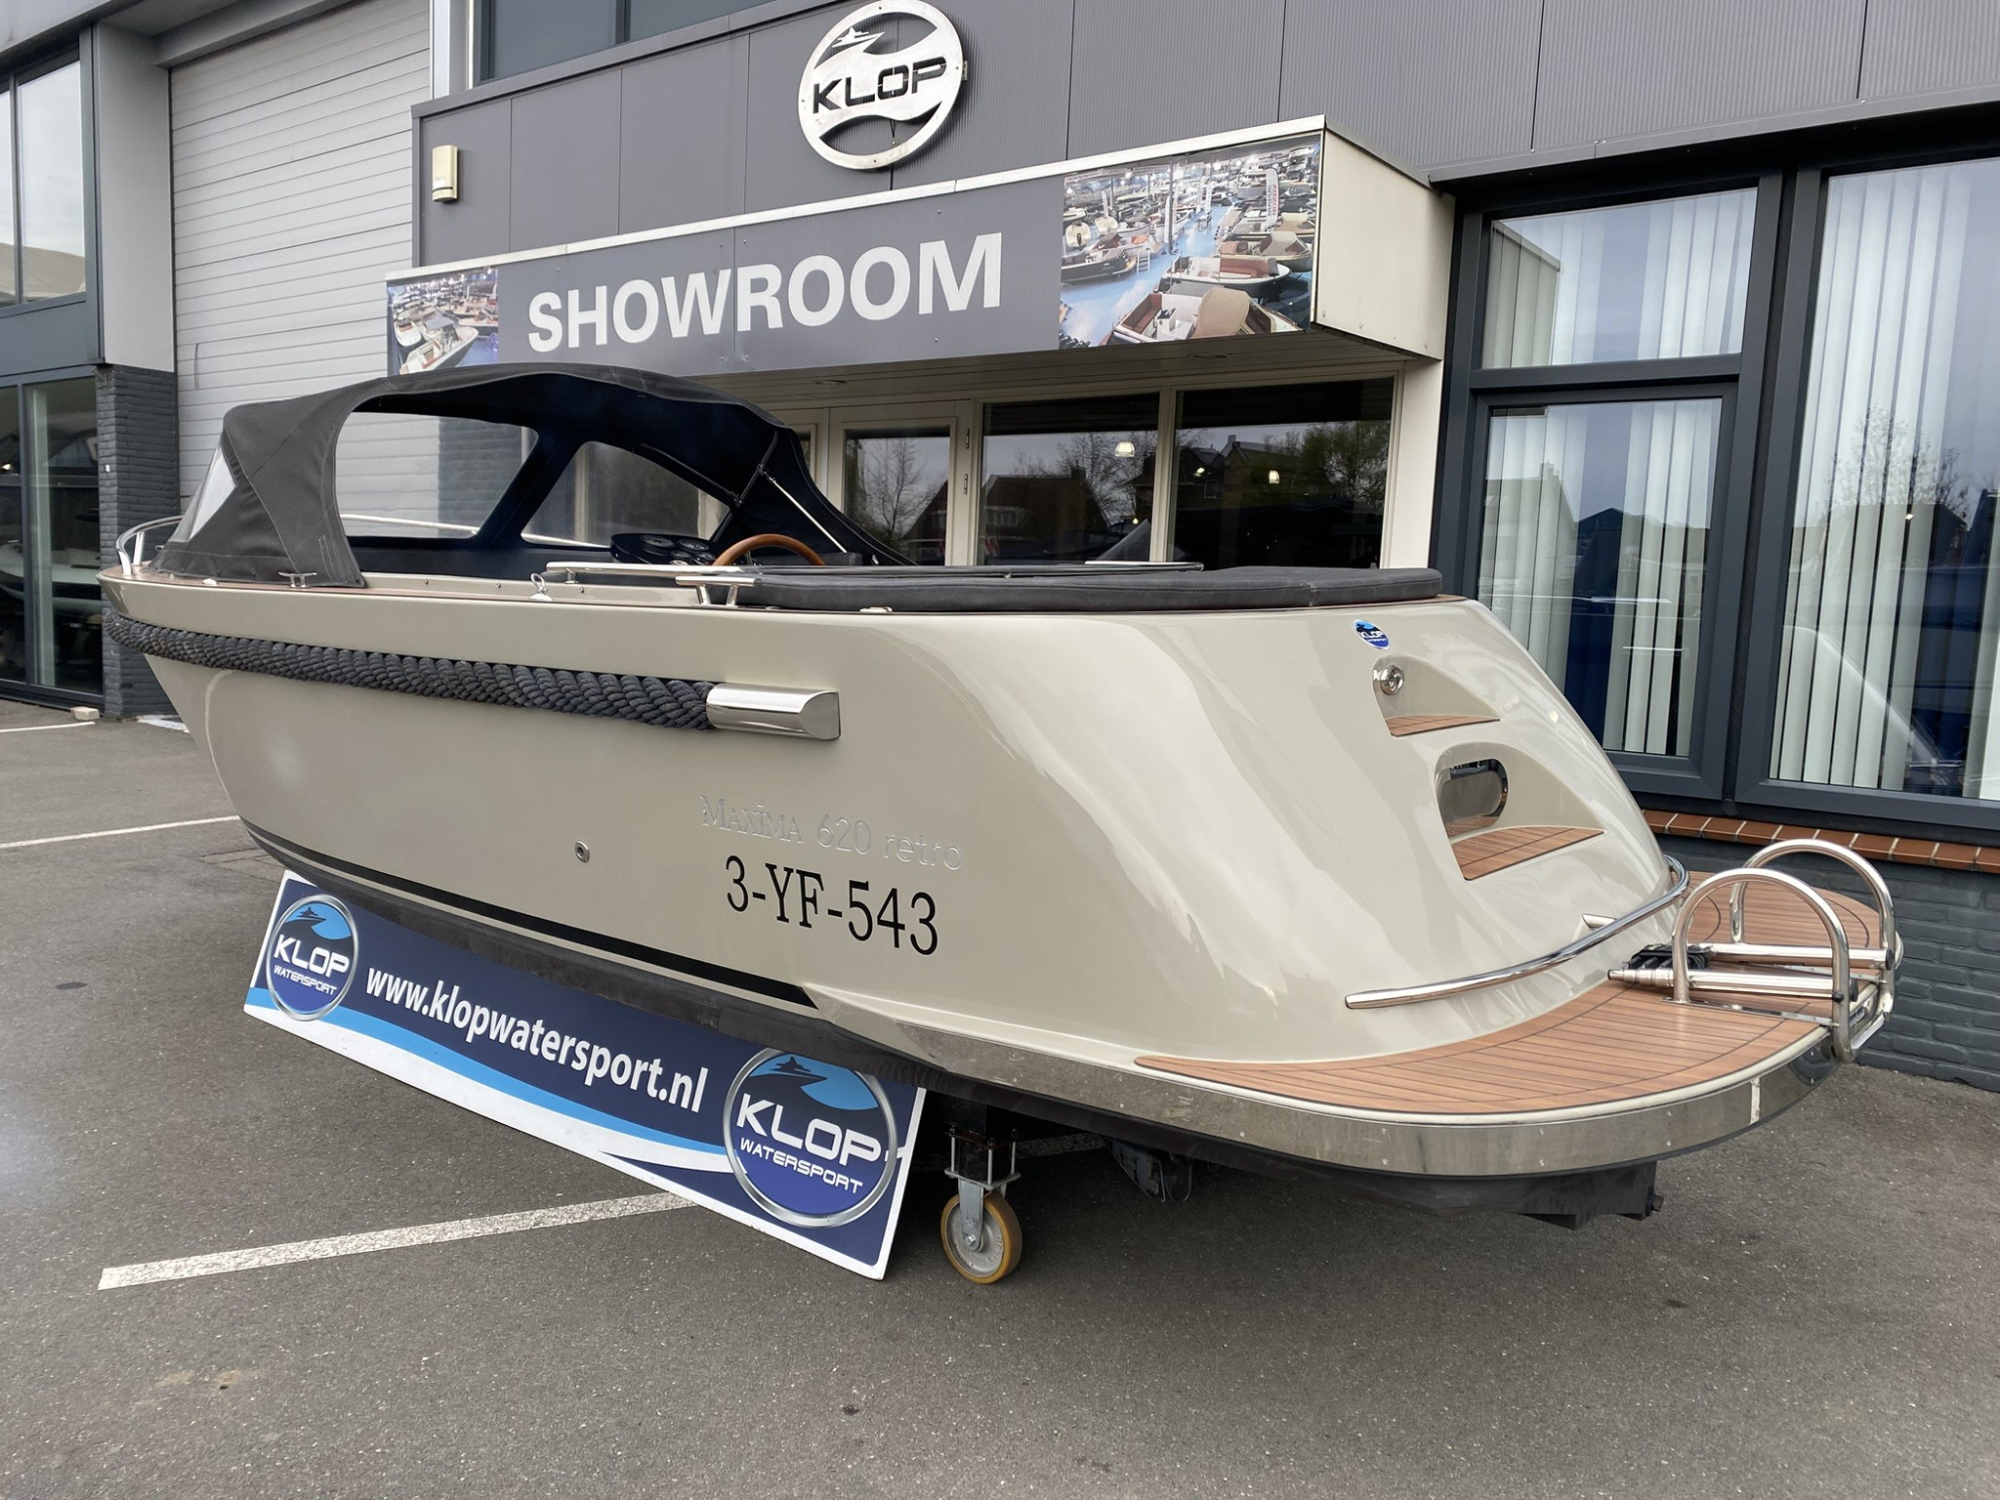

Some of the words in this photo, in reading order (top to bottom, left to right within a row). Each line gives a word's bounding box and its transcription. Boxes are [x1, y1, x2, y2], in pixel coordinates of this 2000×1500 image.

[812, 56, 947, 114] KLOP
[527, 231, 1003, 353] SHOWROOM
[816, 814, 872, 855] 620
[883, 835, 963, 870] retro
[725, 855, 938, 955] 3-YF-543
[273, 934, 350, 978] KLOP
[273, 964, 338, 996] WATERSPORT
[365, 967, 709, 1113] www.klopwatersport.nl
[736, 1093, 882, 1166] KLOP
[739, 1137, 863, 1194] WATERSPORT
